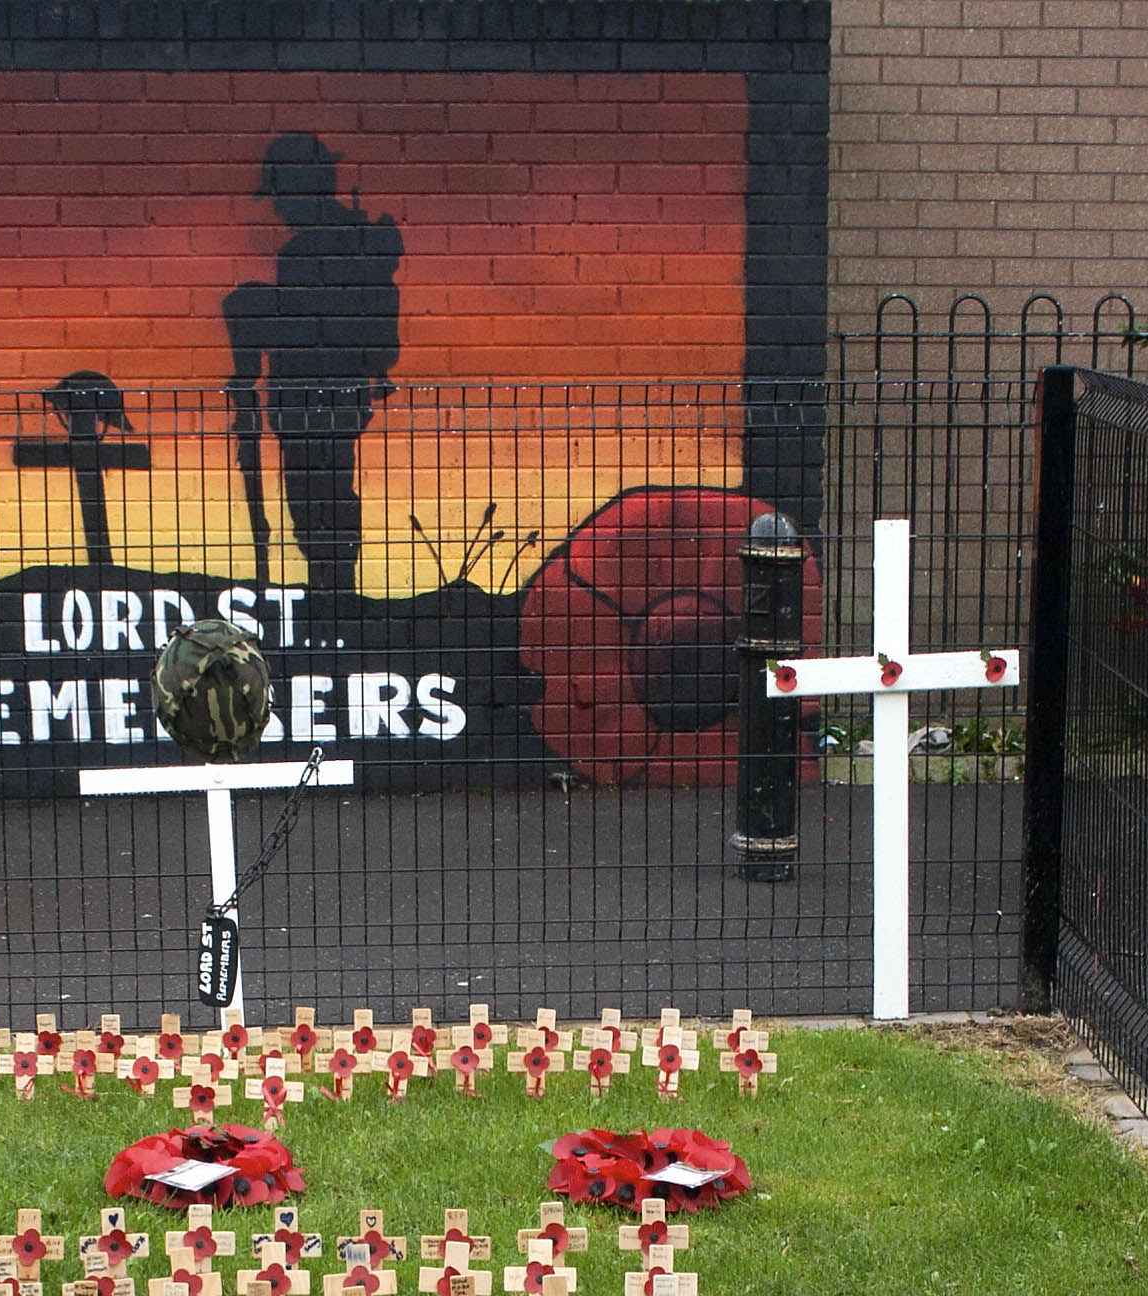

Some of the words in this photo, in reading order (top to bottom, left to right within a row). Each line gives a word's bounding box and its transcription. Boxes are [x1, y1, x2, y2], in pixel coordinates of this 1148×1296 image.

[23, 587, 195, 653] LORD
[201, 922, 213, 949] ST
[198, 951, 213, 995] LORD
